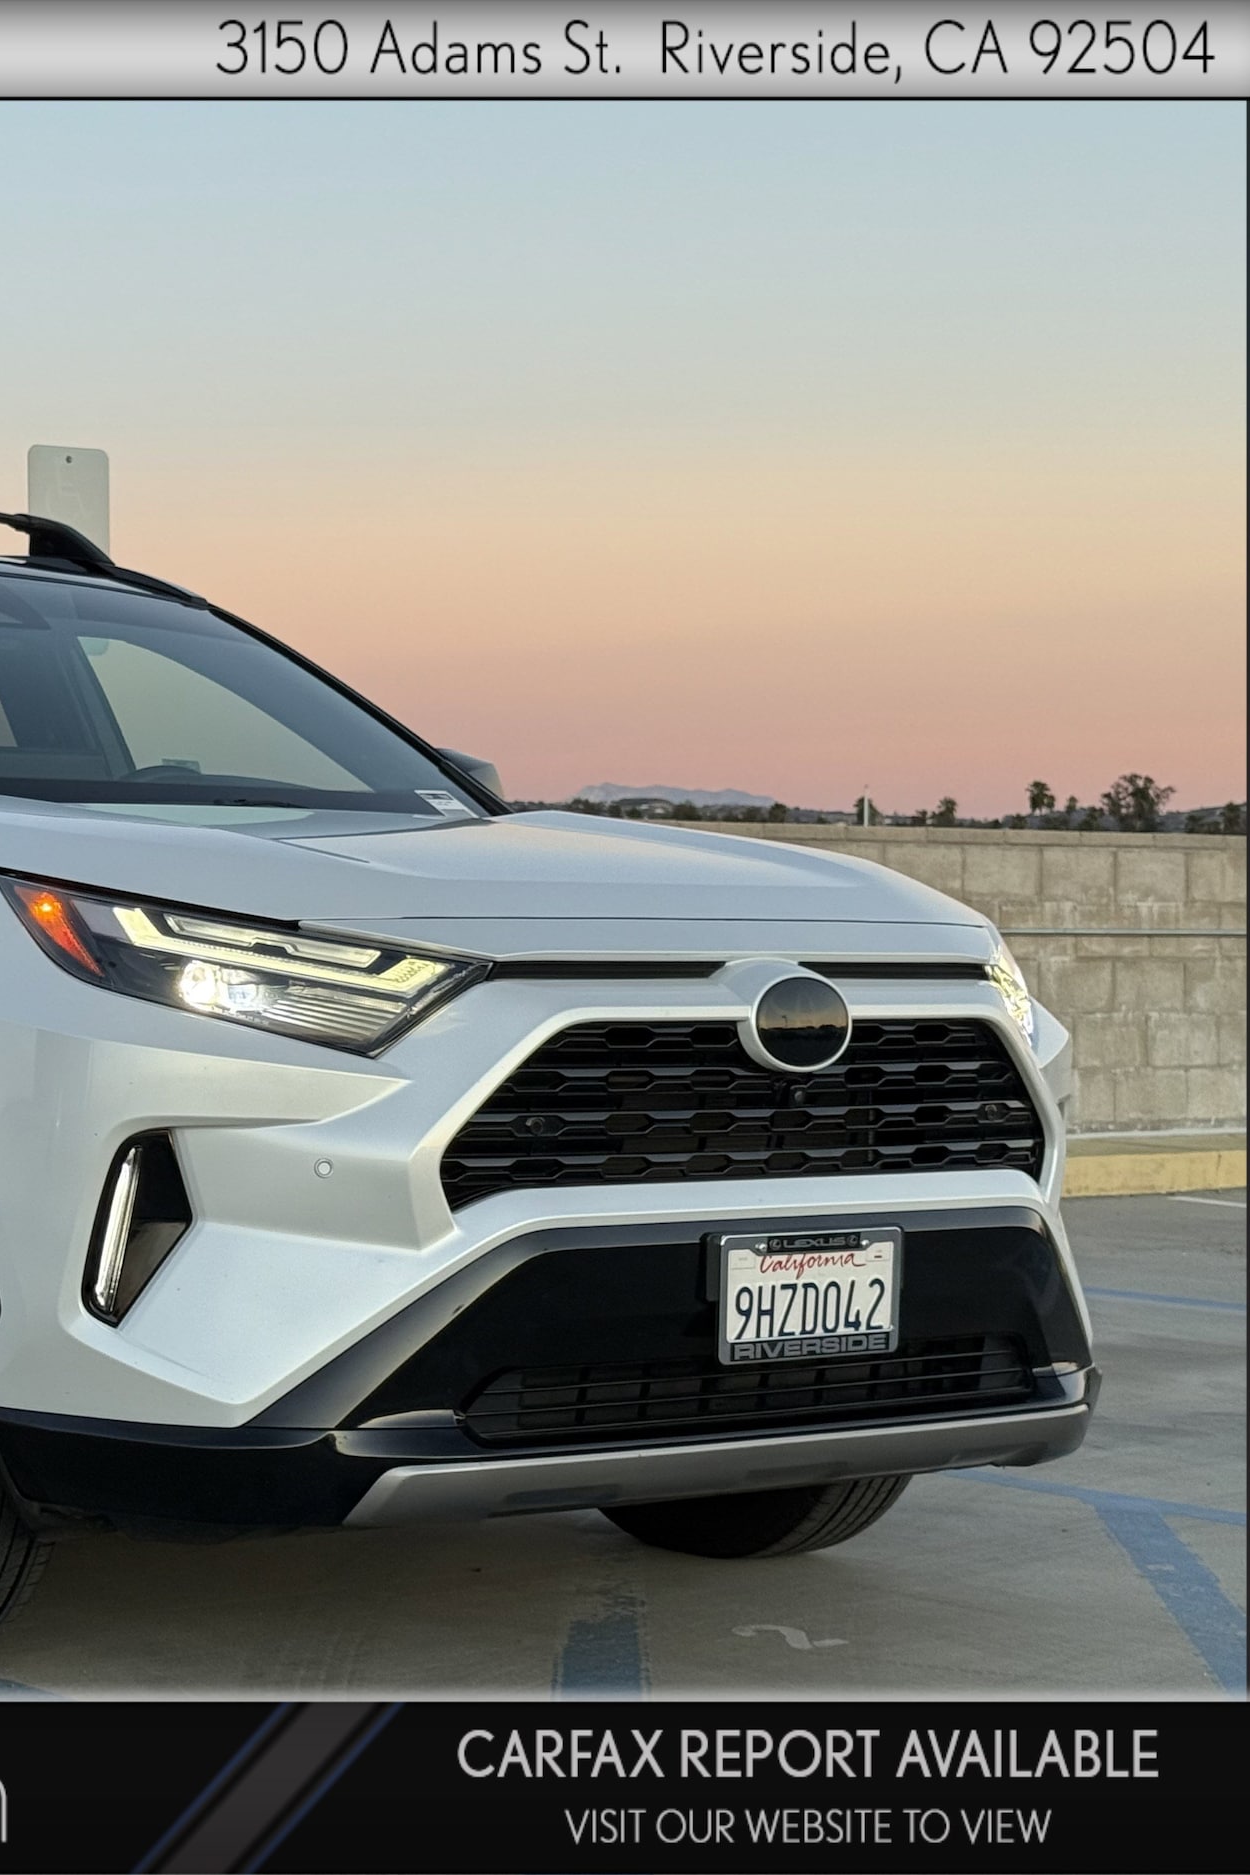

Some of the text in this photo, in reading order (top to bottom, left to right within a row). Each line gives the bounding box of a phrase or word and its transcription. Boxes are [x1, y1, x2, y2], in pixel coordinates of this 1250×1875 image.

[783, 1236, 847, 1249] LEXUS
[759, 1251, 867, 1280] California
[734, 1277, 886, 1341] 9HZD042
[733, 1333, 887, 1361] RIVERSIDE
